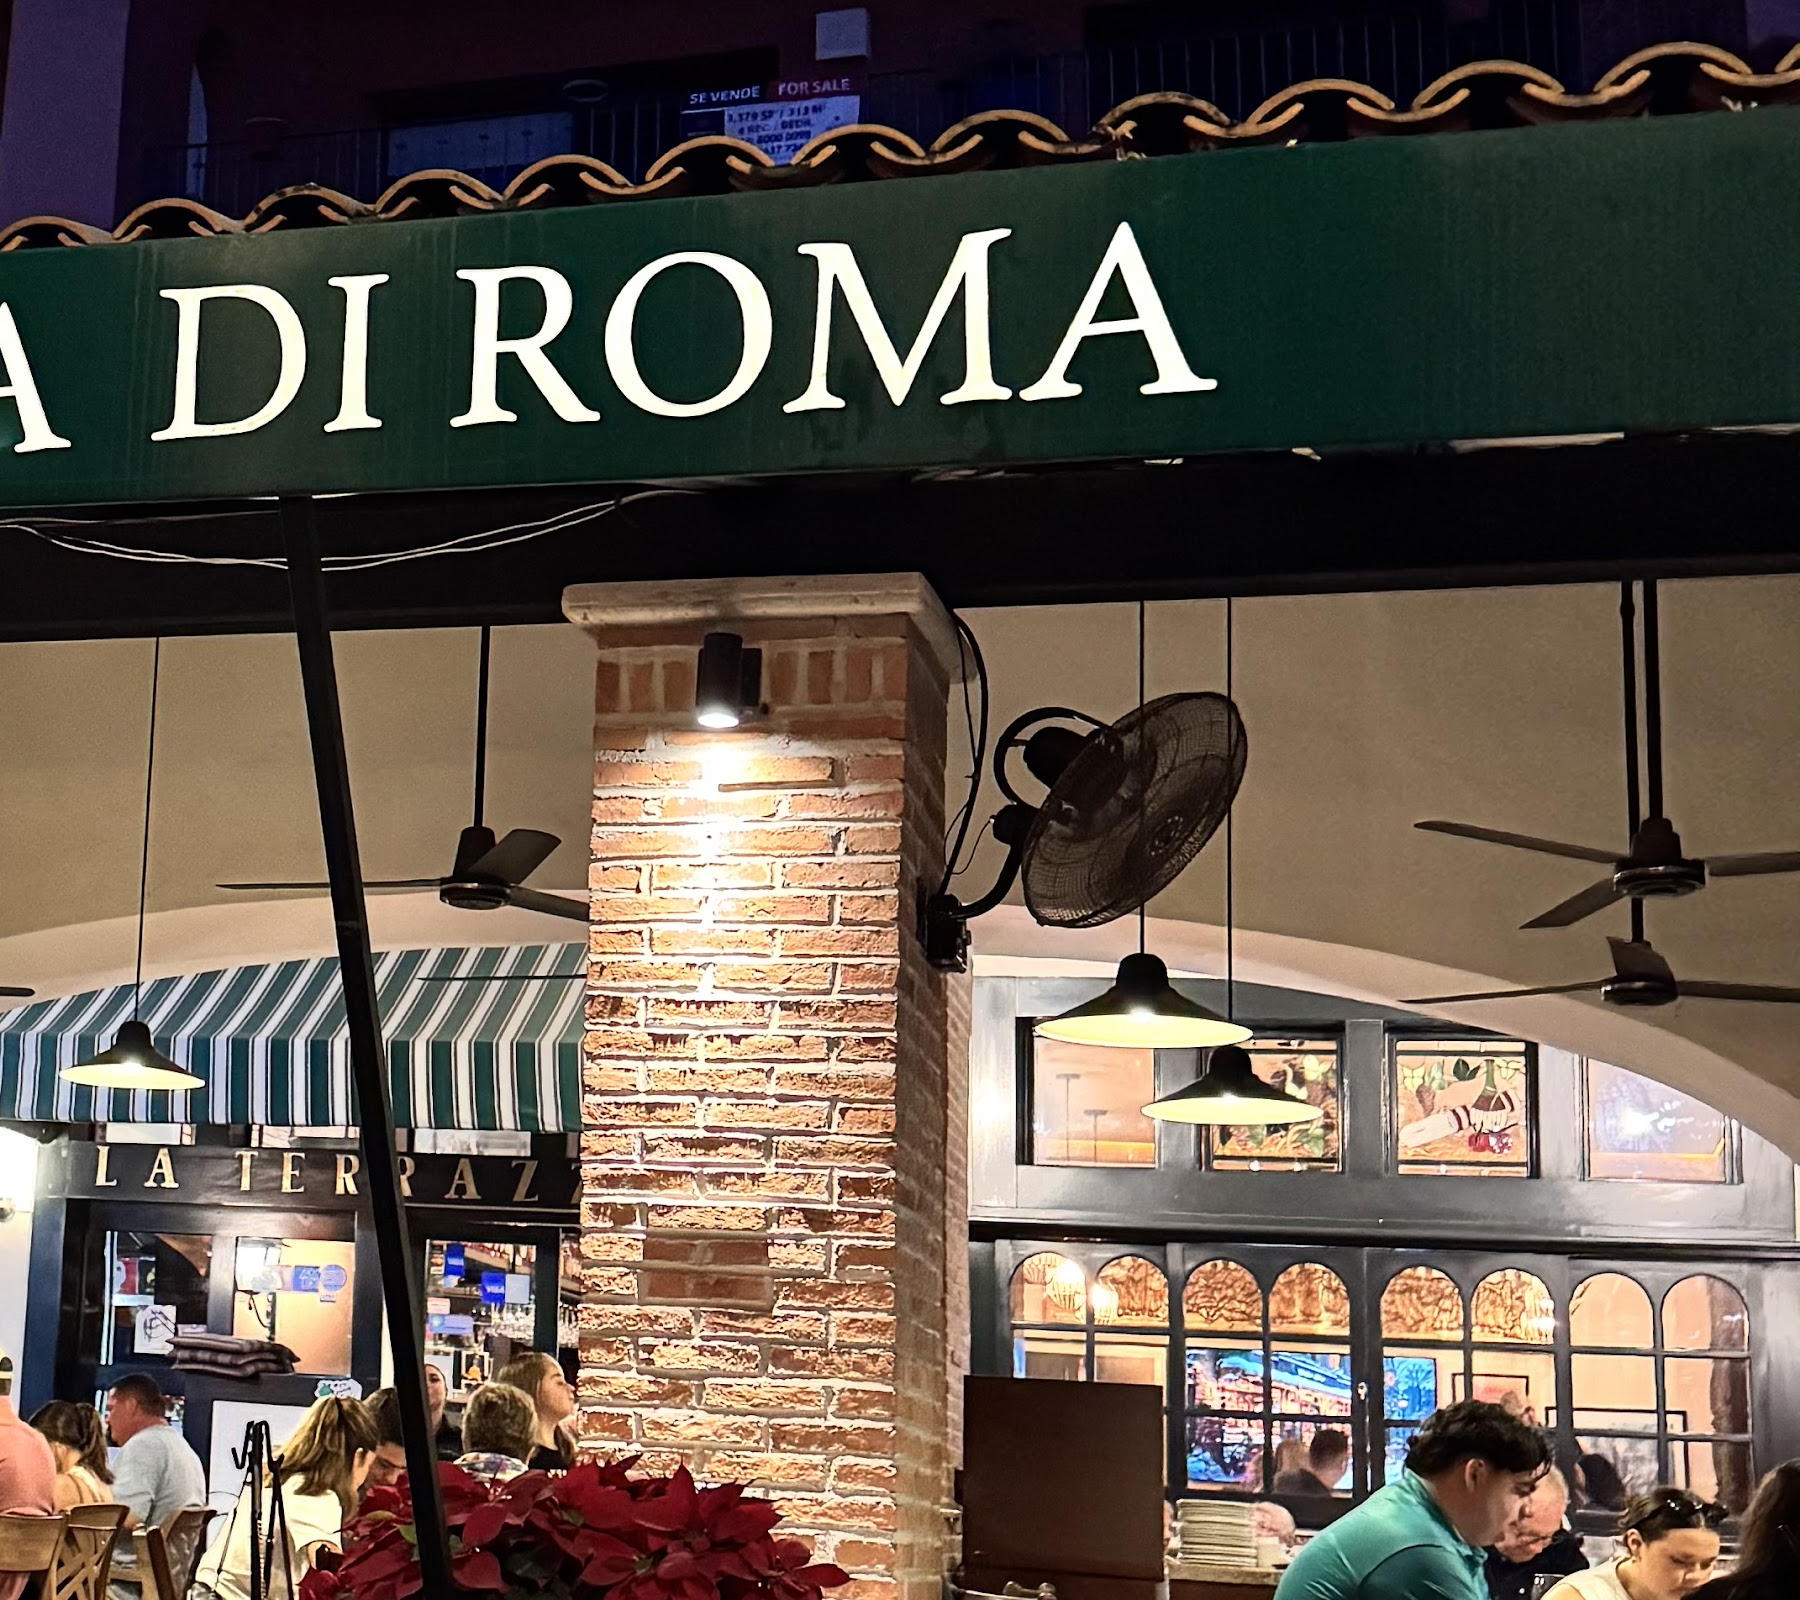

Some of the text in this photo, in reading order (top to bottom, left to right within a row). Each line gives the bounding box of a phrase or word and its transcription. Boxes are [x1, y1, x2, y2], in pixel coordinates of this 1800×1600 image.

[689, 86, 760, 104] SE VENDE
[778, 78, 851, 96] FOR SALE
[151, 274, 390, 443] DI
[449, 221, 1219, 429] ROMA
[94, 1144, 180, 1189] LA
